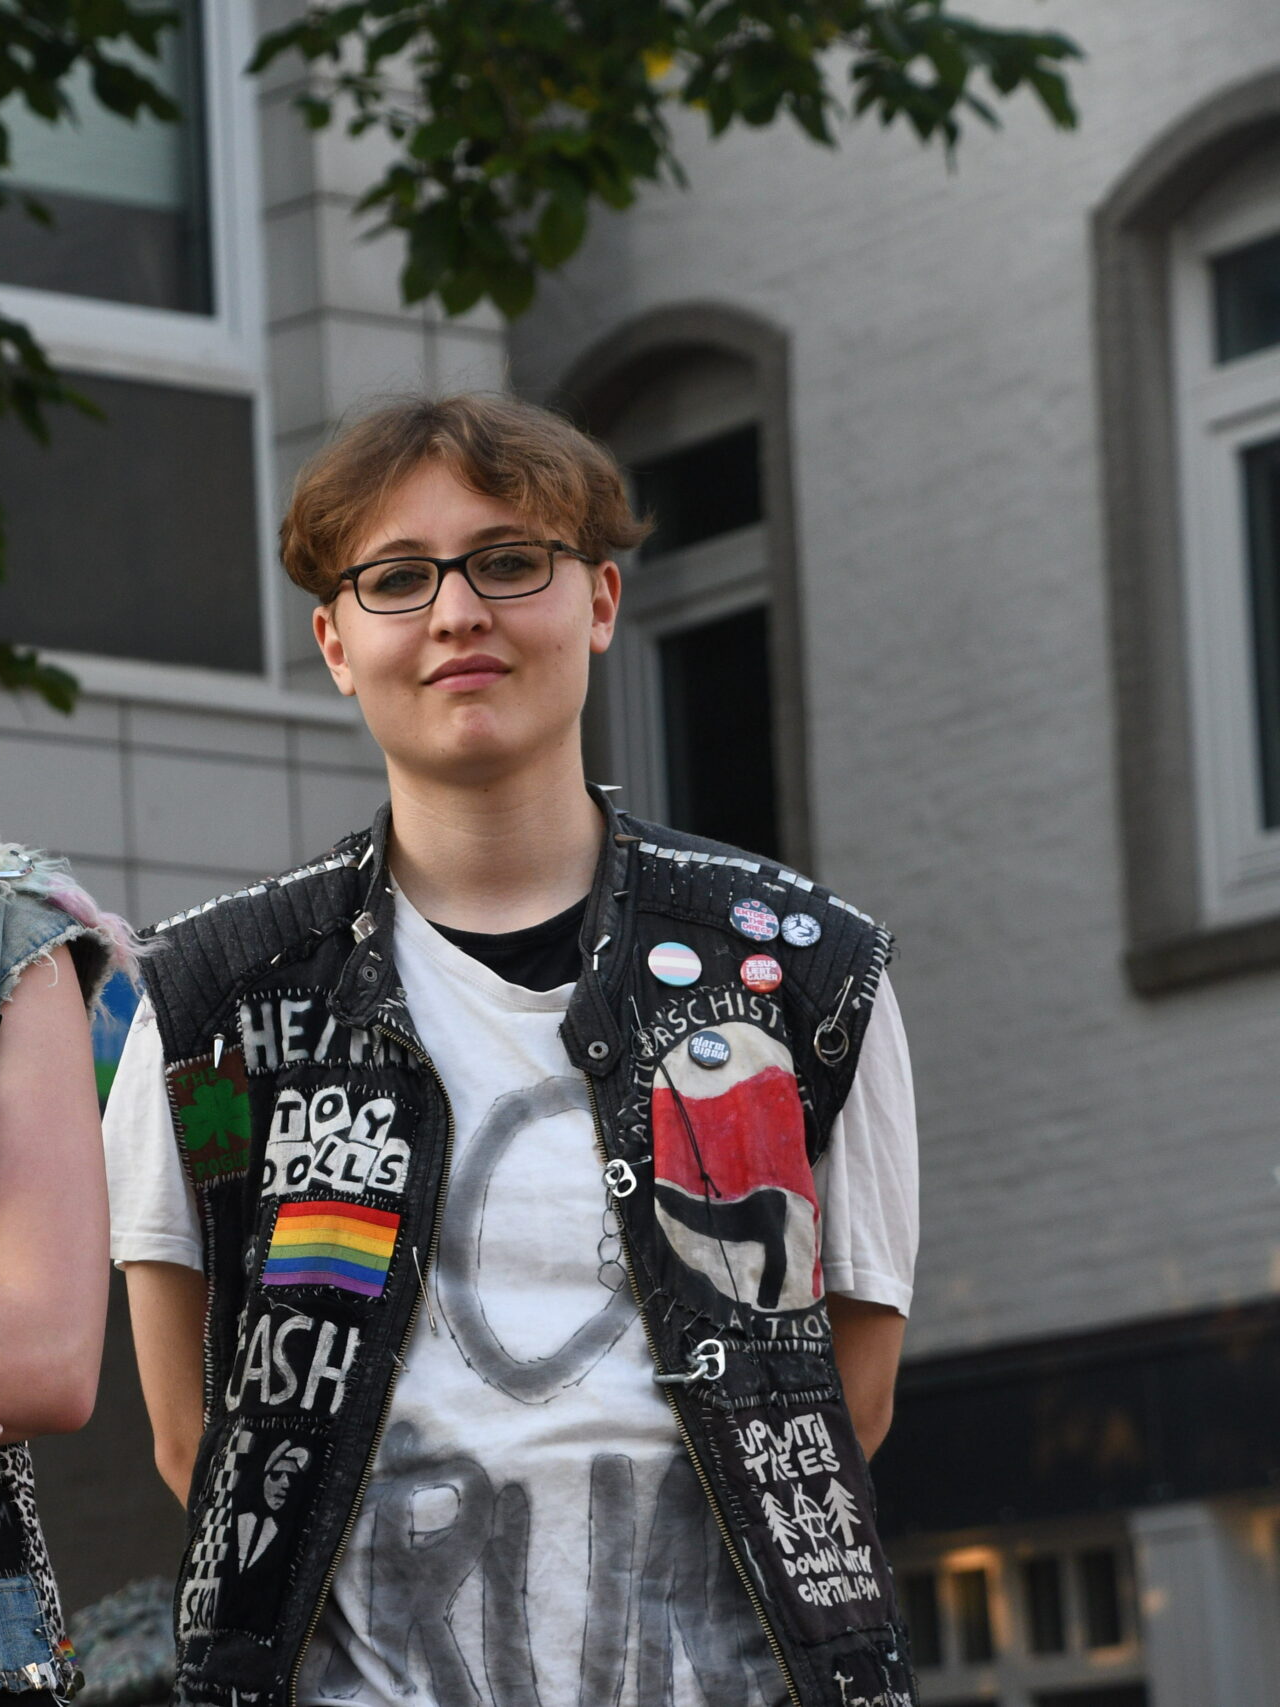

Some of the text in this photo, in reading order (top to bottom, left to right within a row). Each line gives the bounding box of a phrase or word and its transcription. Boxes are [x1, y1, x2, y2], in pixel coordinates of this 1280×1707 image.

[745, 959, 777, 968] JESUS
[176, 1065, 218, 1089] THE
[276, 1092, 392, 1140] TOY
[739, 1411, 833, 1453] UP WITH
[743, 1447, 841, 1484] TREES
[782, 1545, 873, 1579] DOWN WITH
[182, 1587, 216, 1633] SKA
